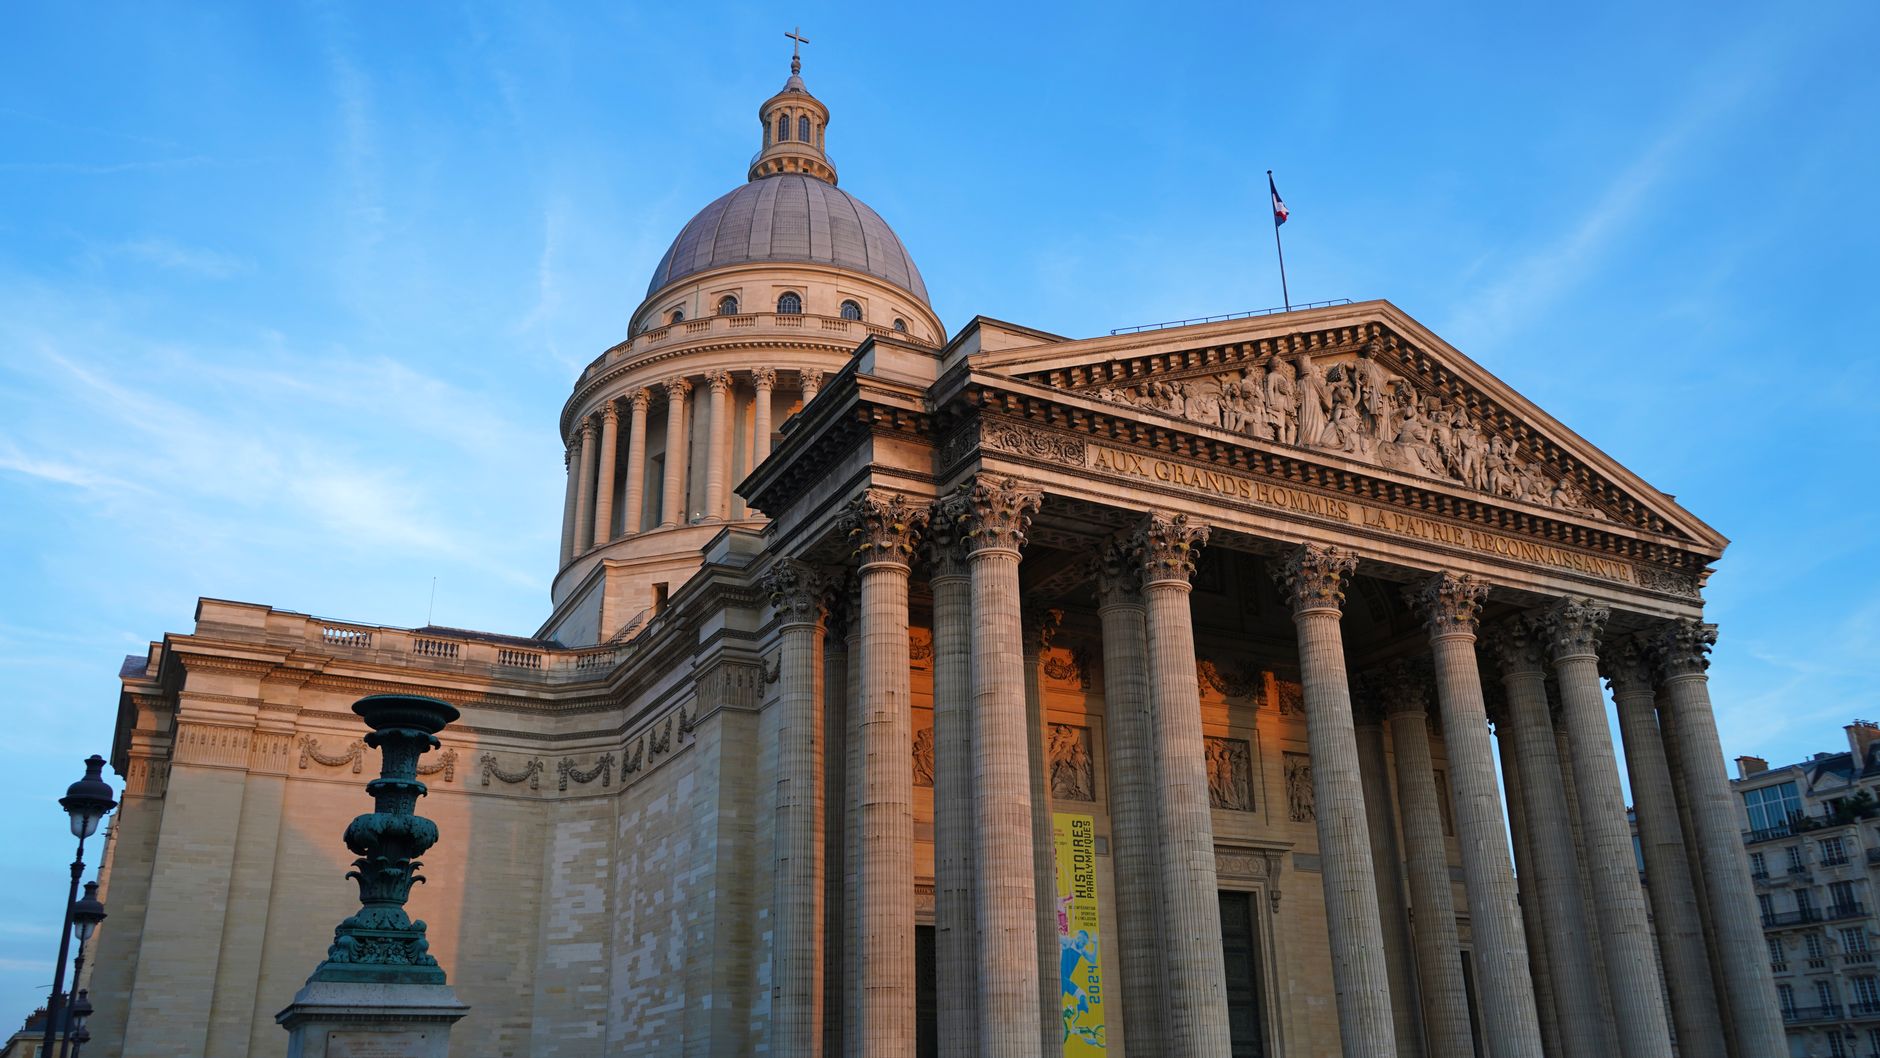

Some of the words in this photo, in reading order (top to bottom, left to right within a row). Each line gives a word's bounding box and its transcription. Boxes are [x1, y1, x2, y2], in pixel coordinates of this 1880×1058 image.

[1094, 448, 1148, 477] AUX
[1155, 461, 1251, 499] GRANDS
[1255, 482, 1349, 520] HOMMES
[1361, 506, 1390, 530] LA
[1393, 513, 1466, 547] PATRIE
[1469, 530, 1629, 582] RECONNAISSANTE
[1072, 820, 1086, 898] HISTOIRES
[1083, 820, 1095, 899] PARALYMPIQUES
[1088, 965, 1100, 1004] 2024
